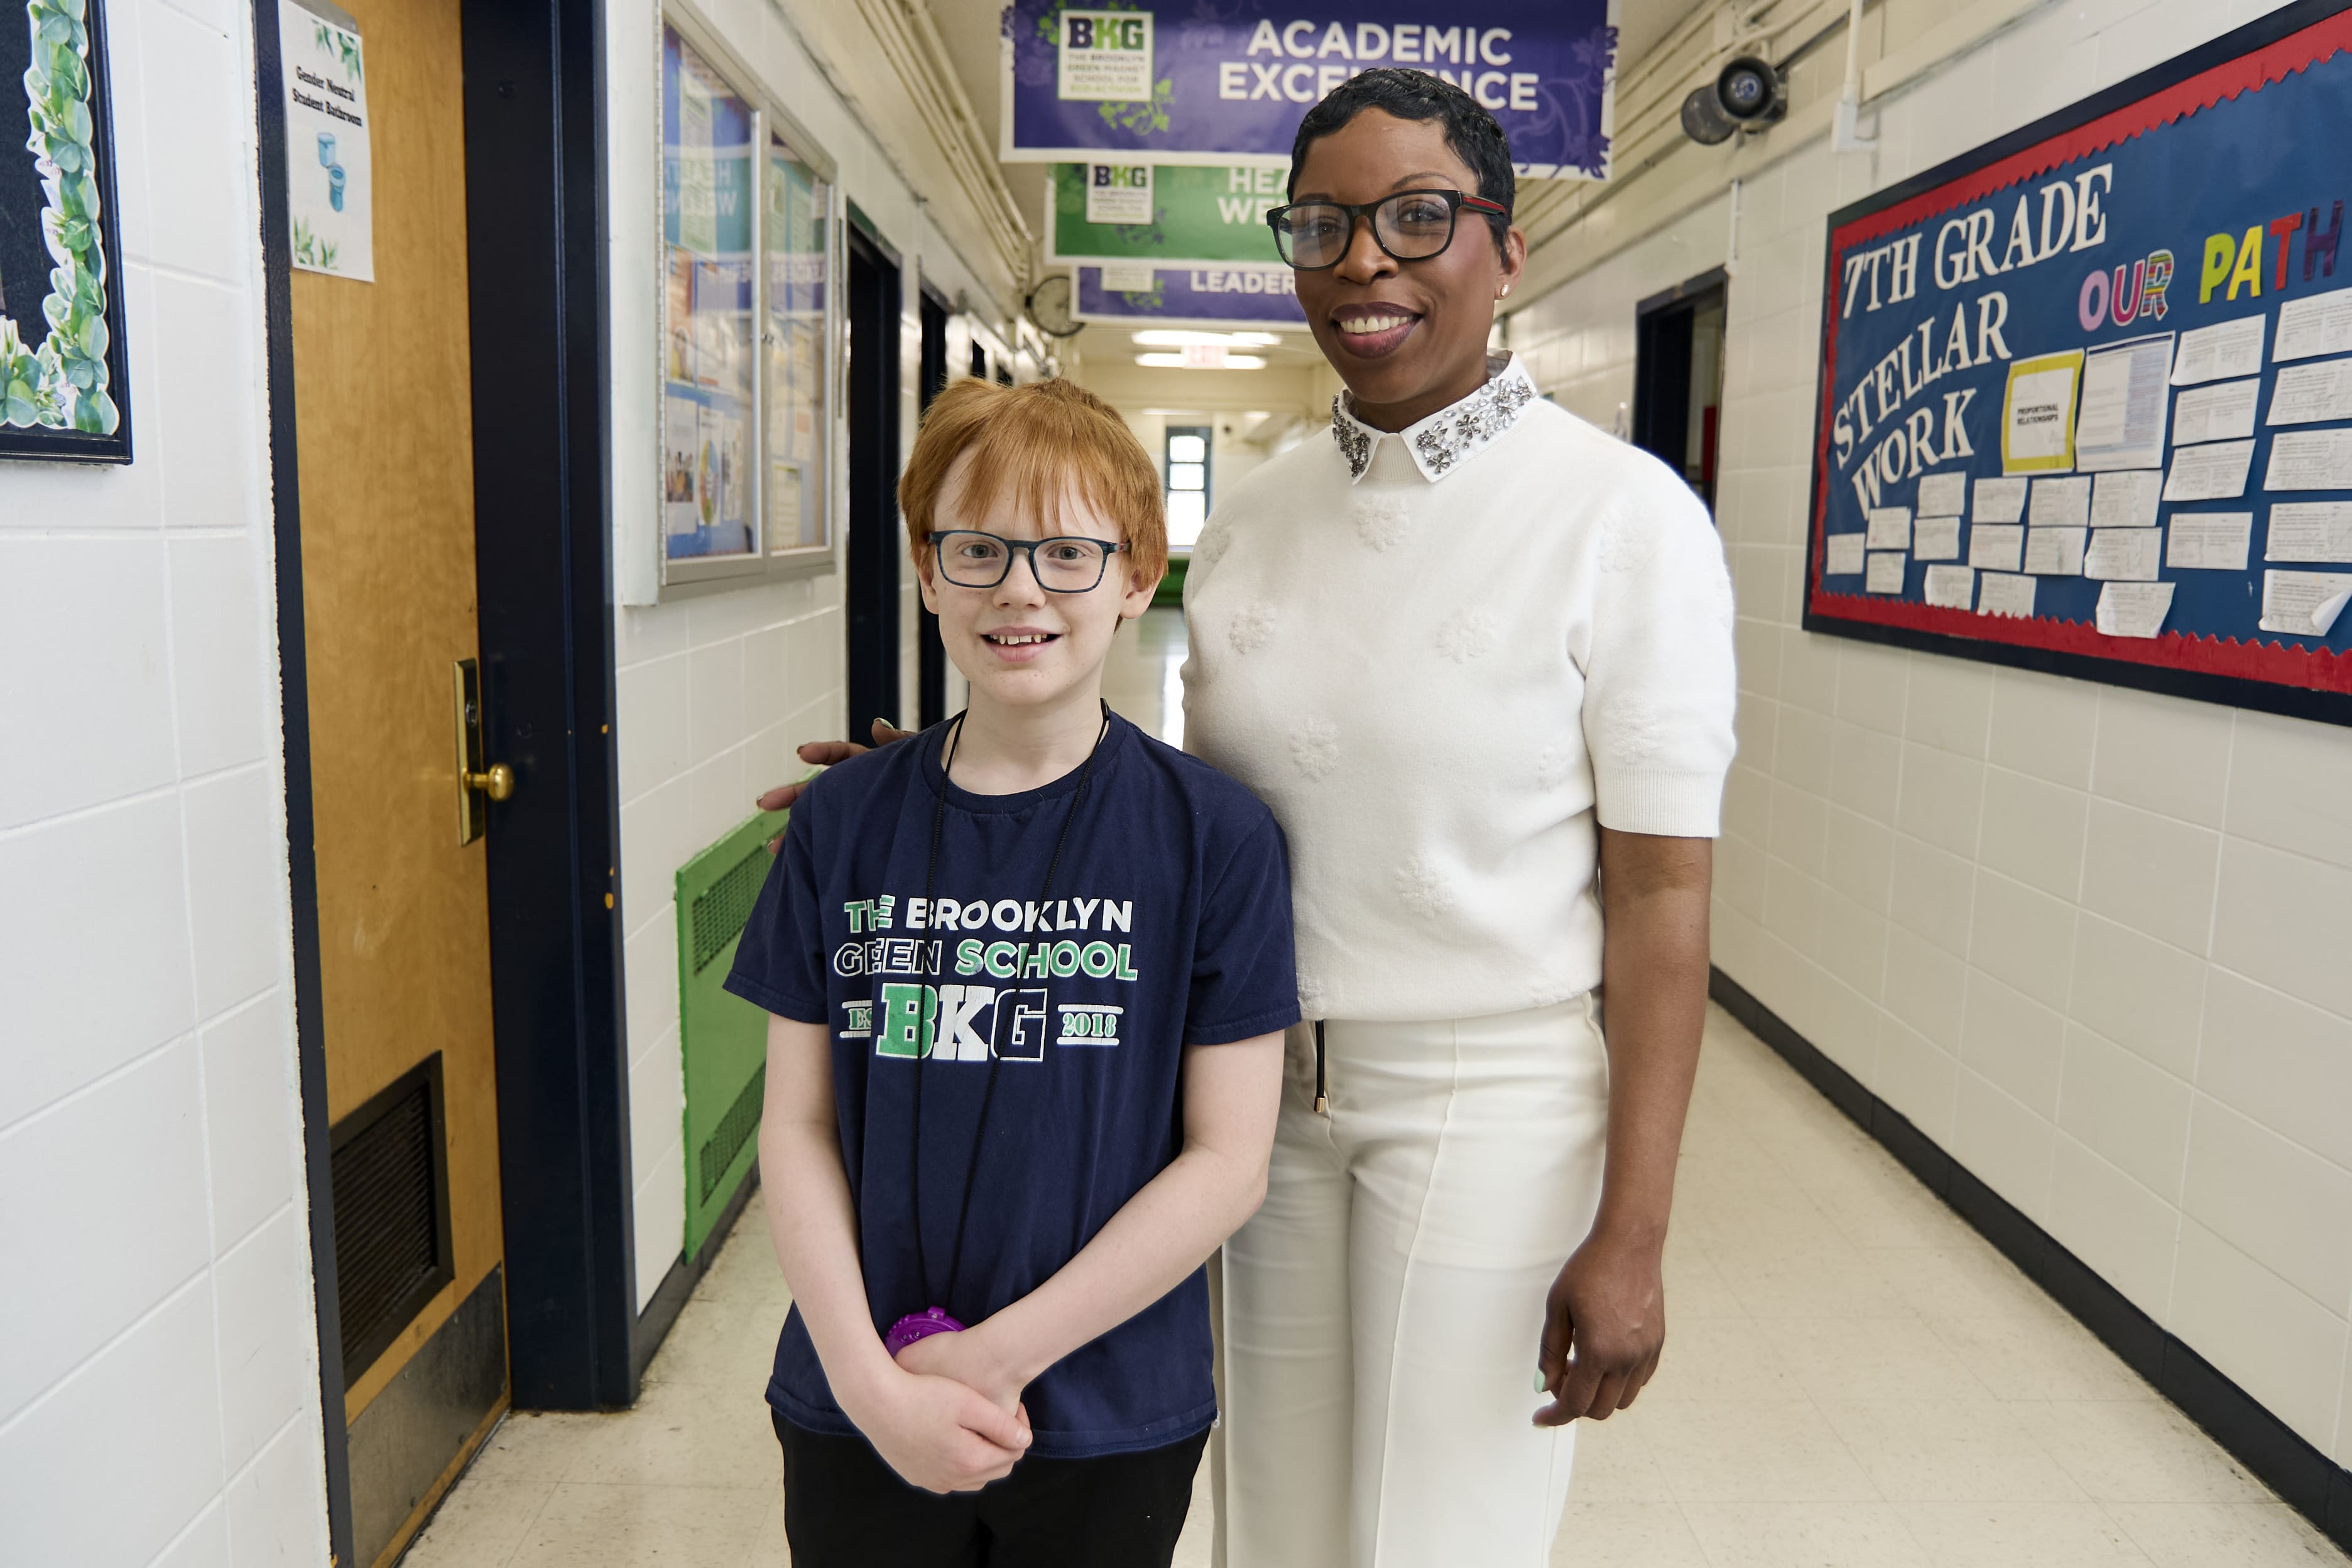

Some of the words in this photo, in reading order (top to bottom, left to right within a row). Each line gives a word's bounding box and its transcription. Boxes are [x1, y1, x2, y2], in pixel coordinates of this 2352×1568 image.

[1069, 18, 1144, 50] BKG
[1246, 19, 1512, 65] ACADEMIC
[296, 65, 324, 89] Gender
[326, 77, 355, 102] Neutral
[1219, 63, 1538, 111] EXCENCE
[292, 87, 324, 112] Student
[326, 101, 362, 126] Bathroom
[1094, 166, 1146, 187] BKG
[1843, 232, 1922, 319] 7TH
[1934, 163, 2113, 290] GRADE
[2079, 249, 2174, 332] OUR
[2199, 199, 2344, 305] PATH
[1833, 291, 2012, 470] STELLAR
[1852, 388, 1976, 521] WORK
[844, 894, 896, 933] THE
[906, 896, 1133, 933] BROOKLYN
[954, 939, 1138, 981] SCHOOL
[876, 983, 1048, 1062] BKG
[1062, 1012, 1117, 1037] 2018
